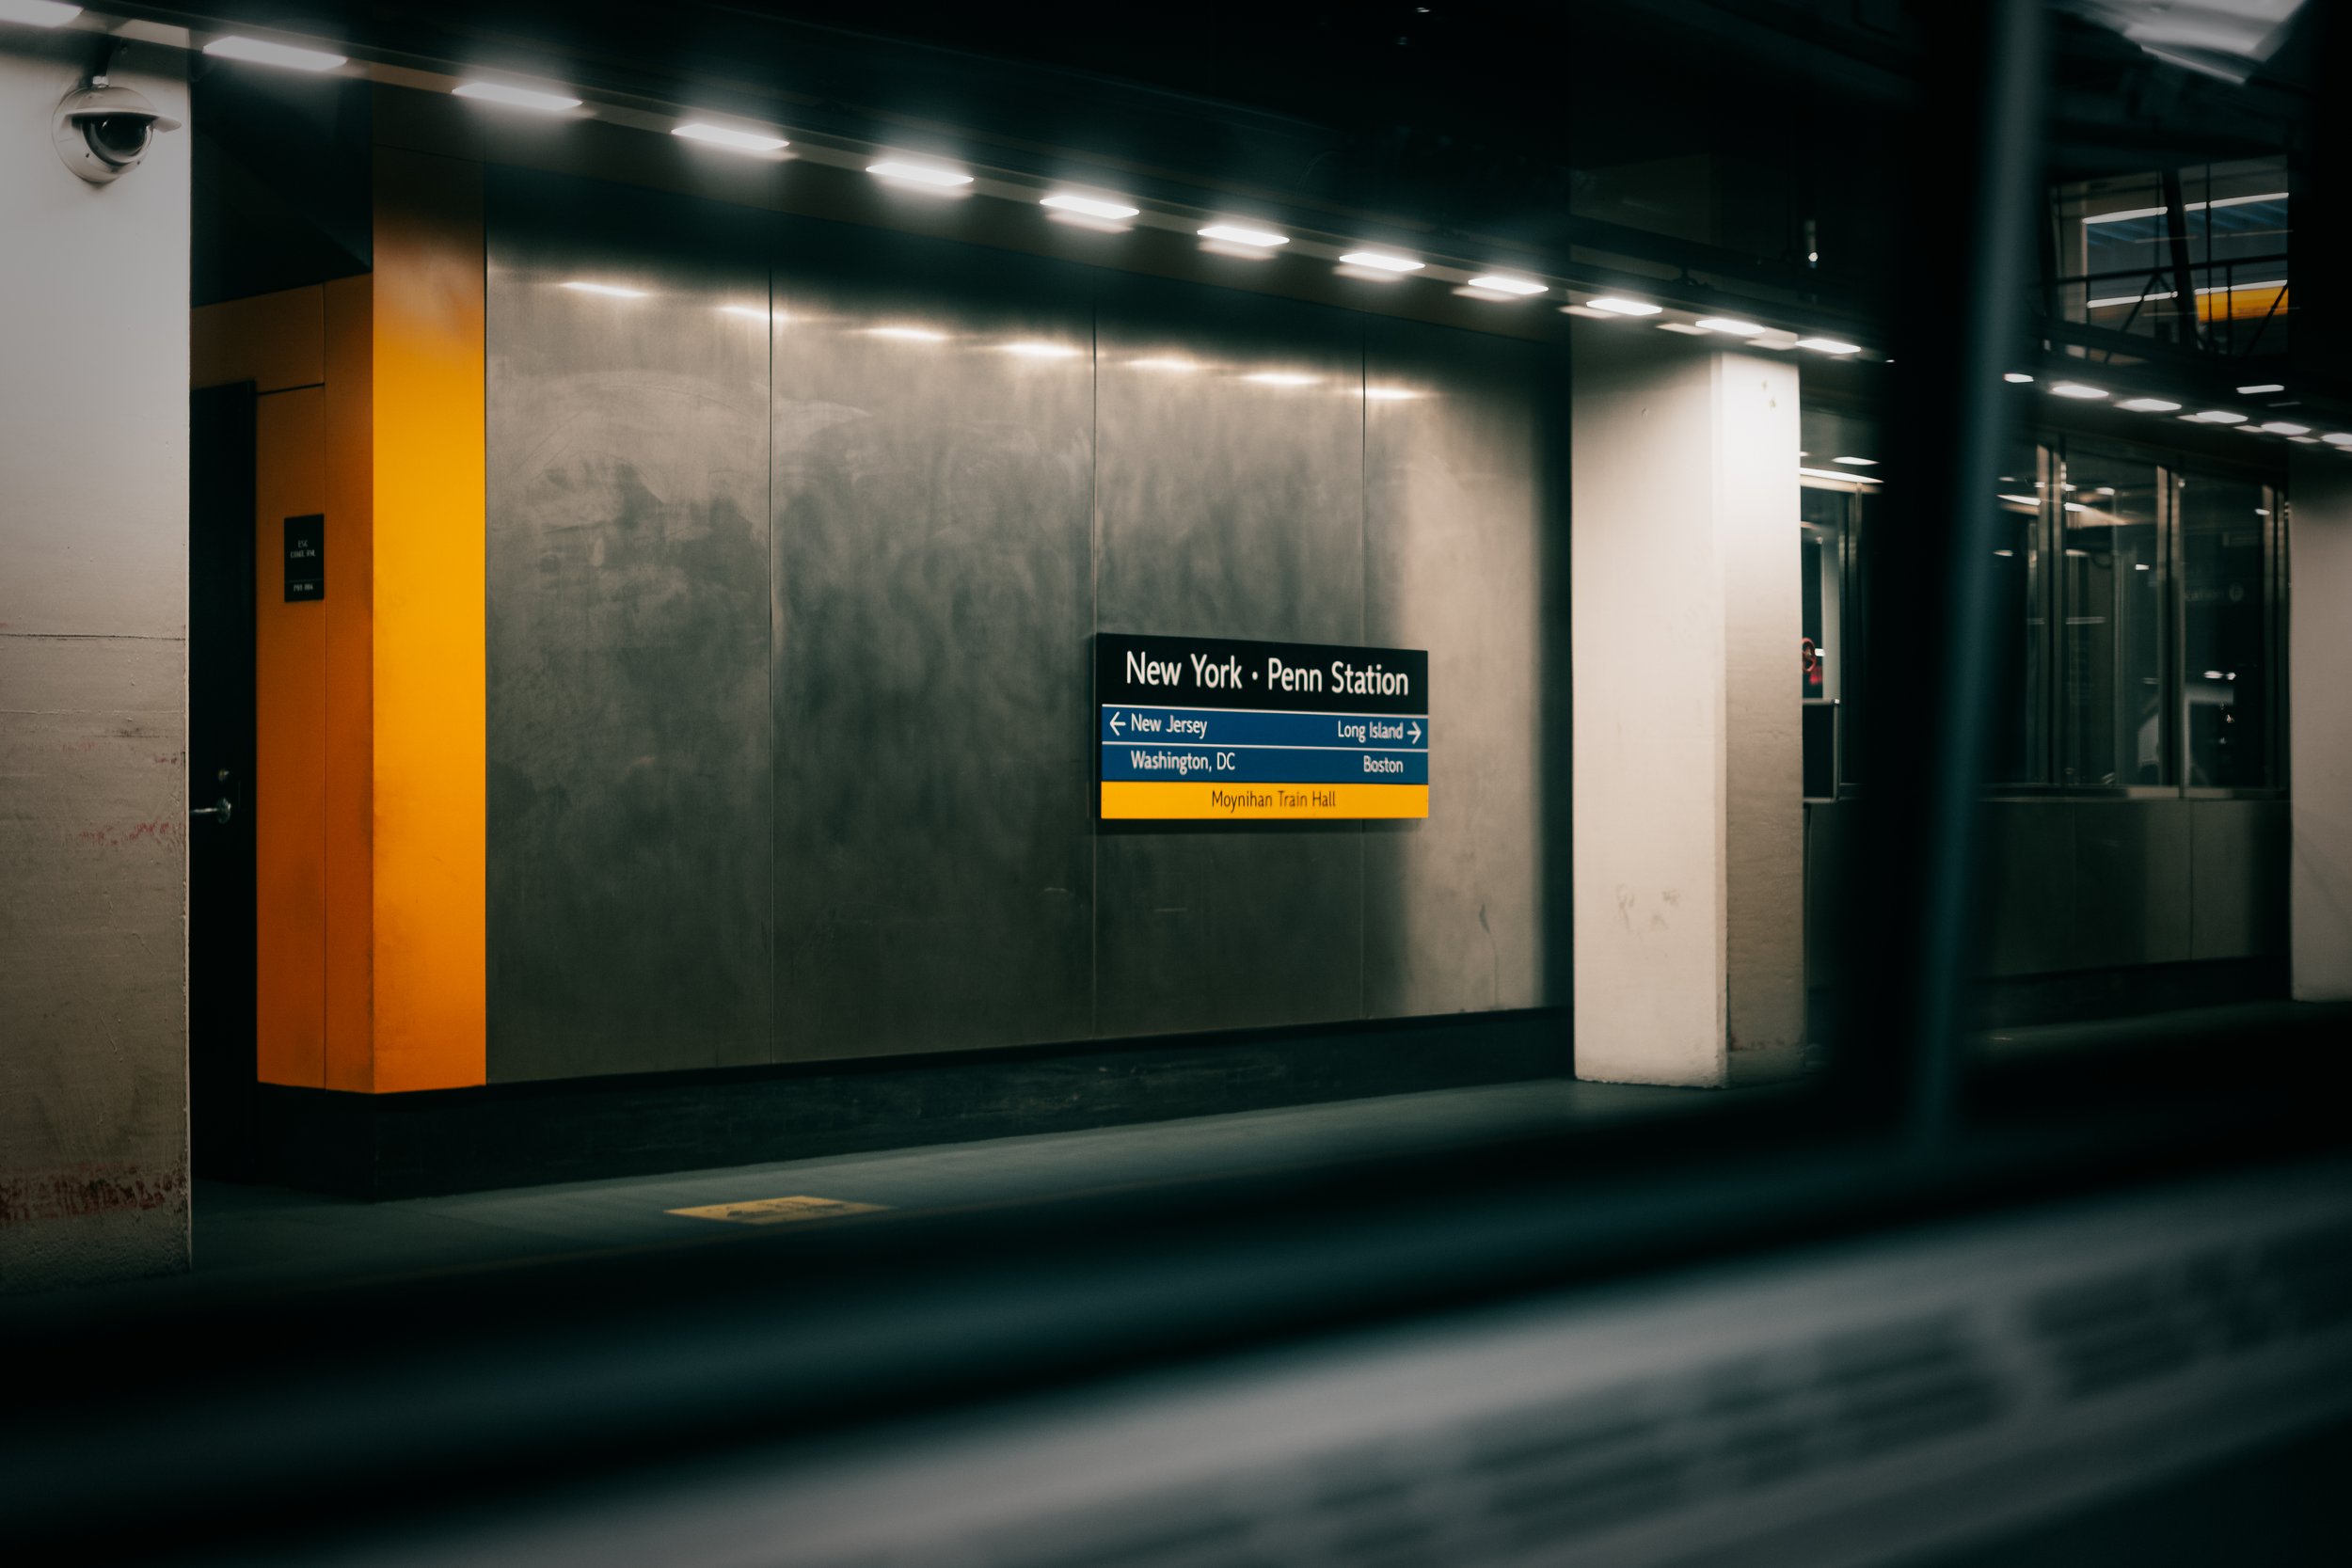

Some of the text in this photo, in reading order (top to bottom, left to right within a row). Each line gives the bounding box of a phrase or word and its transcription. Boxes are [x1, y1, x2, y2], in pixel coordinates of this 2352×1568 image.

[1126, 650, 1182, 686] New
[1190, 653, 1243, 689] York
[1267, 657, 1323, 692] Penn
[1331, 660, 1409, 696] Station
[1131, 712, 1208, 740] New Jersey
[1338, 720, 1404, 743] Long Island
[1130, 750, 1235, 776] Washington, DC
[1363, 754, 1404, 773] Boston
[1212, 789, 1336, 814] Moynihan Train Hall
